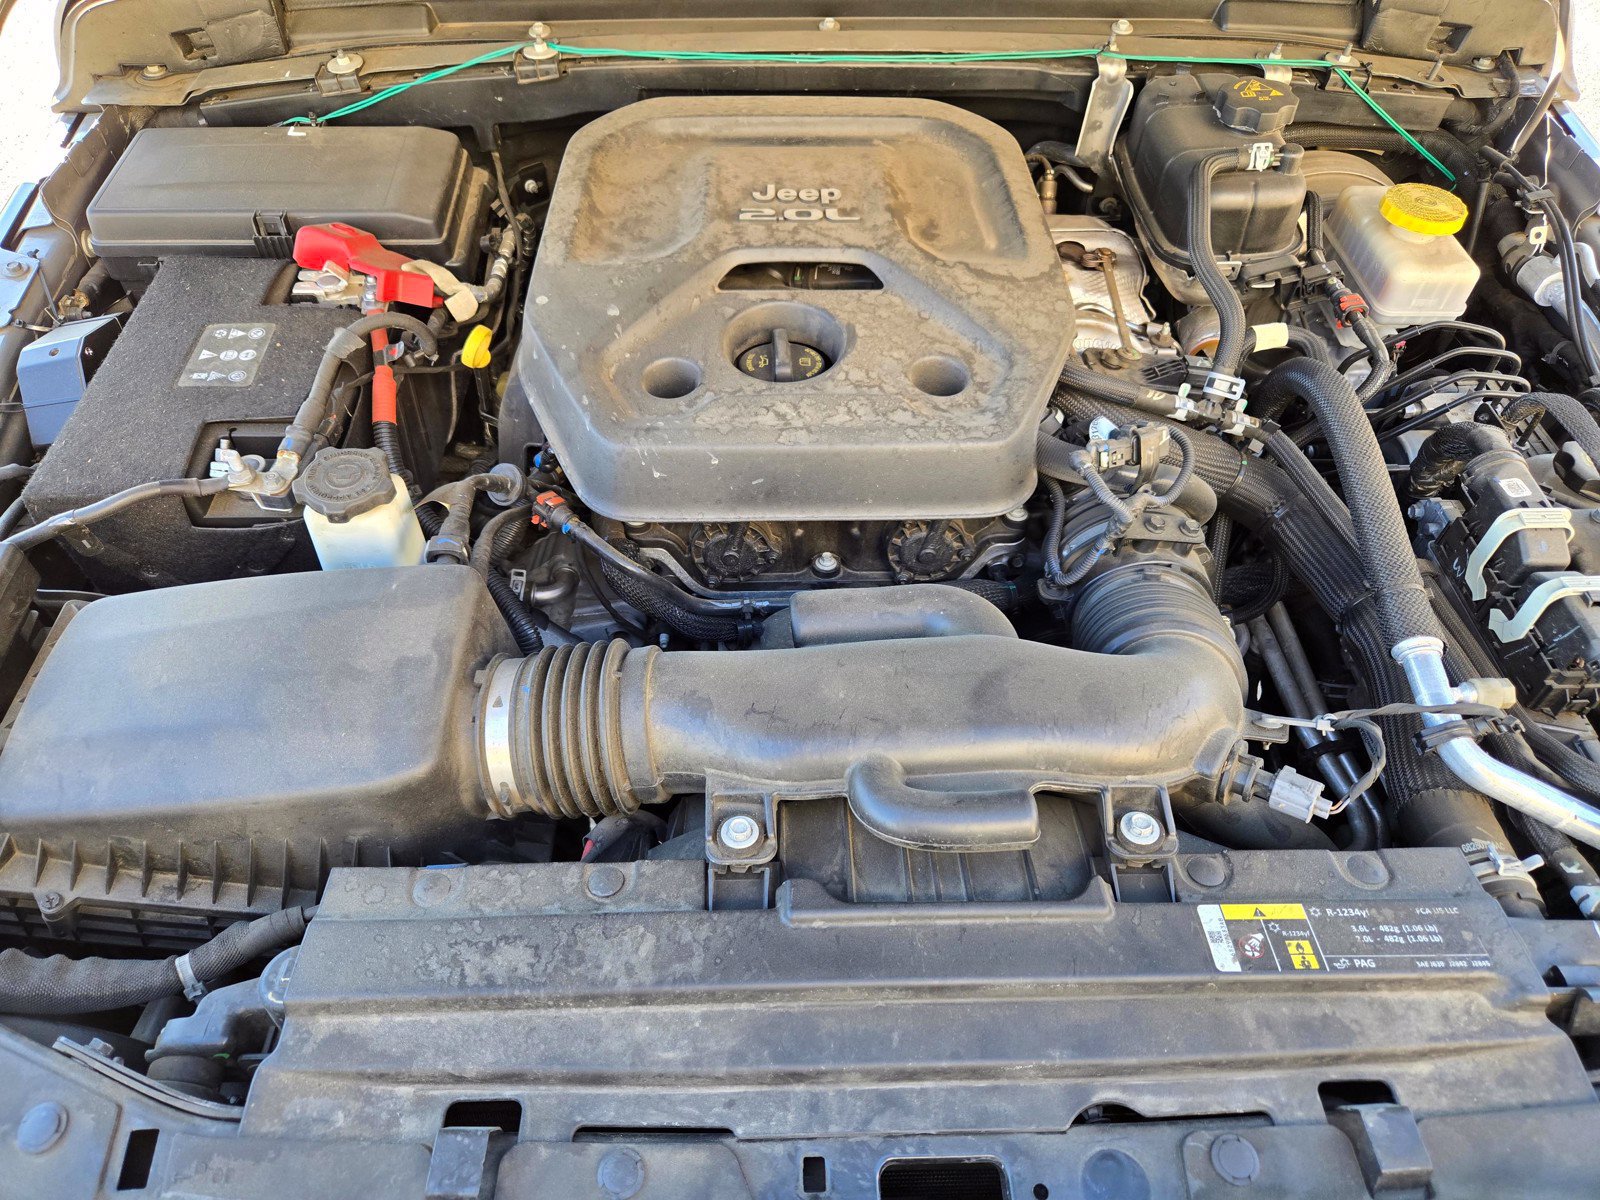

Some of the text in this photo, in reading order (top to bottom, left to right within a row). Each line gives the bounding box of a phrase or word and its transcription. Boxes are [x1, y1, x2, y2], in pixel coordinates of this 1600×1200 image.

[752, 183, 842, 206] Jeep
[738, 207, 861, 221] 2.0L
[1415, 907, 1432, 915] FCA
[1281, 930, 1310, 938] R-1234yf
[1379, 925, 1400, 934] 482g
[1402, 925, 1423, 933] (1.06
[1423, 925, 1438, 933] Lb)
[1383, 935, 1405, 944] 482g
[1406, 934, 1429, 943] (1.06
[1428, 934, 1443, 943] Lb)
[1353, 958, 1376, 968] PAG
